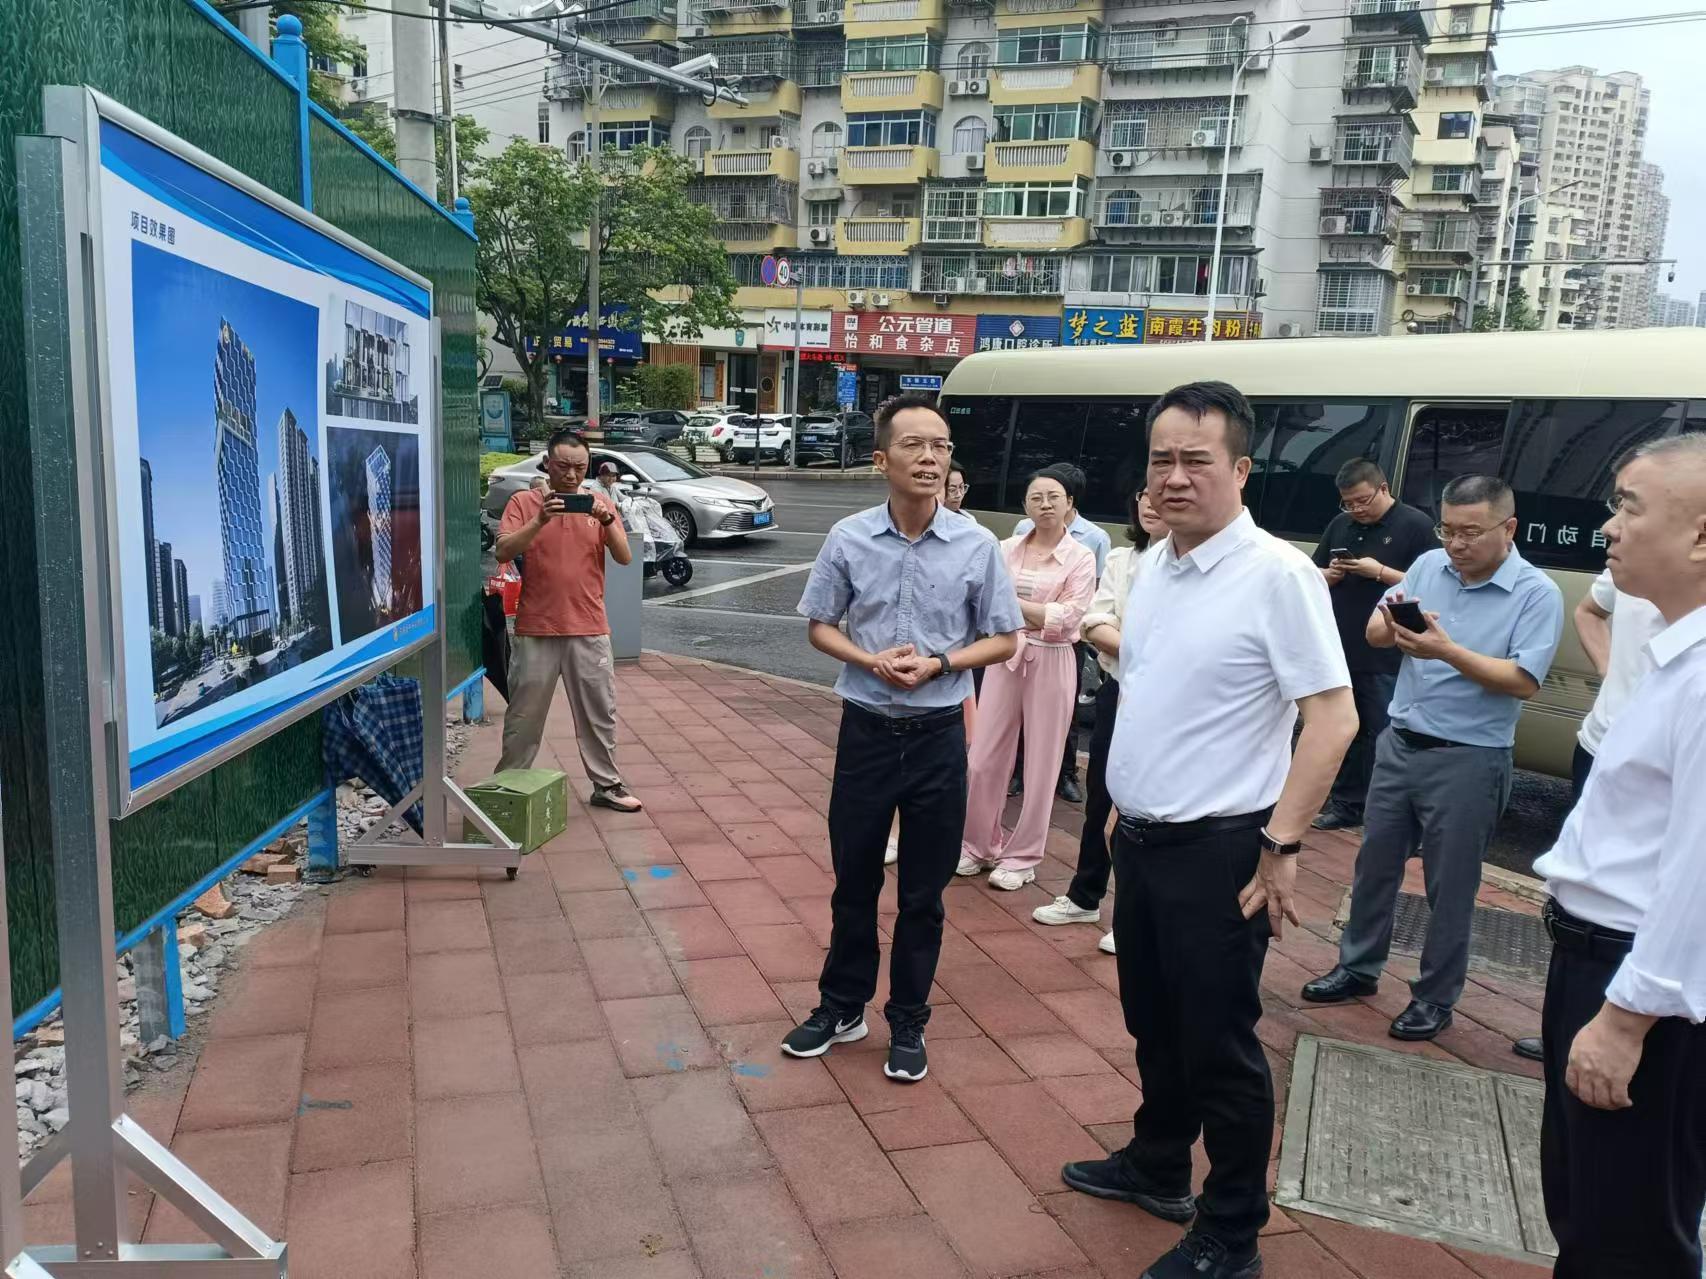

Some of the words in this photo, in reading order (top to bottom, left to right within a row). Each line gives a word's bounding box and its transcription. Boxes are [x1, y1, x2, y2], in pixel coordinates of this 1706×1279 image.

[131, 211, 176, 245] 项目效果图
[779, 265, 788, 279] 40
[879, 315, 953, 335] 公元管道
[1068, 310, 1139, 339] 梦之蓝
[844, 332, 961, 353] 怡和食杂店
